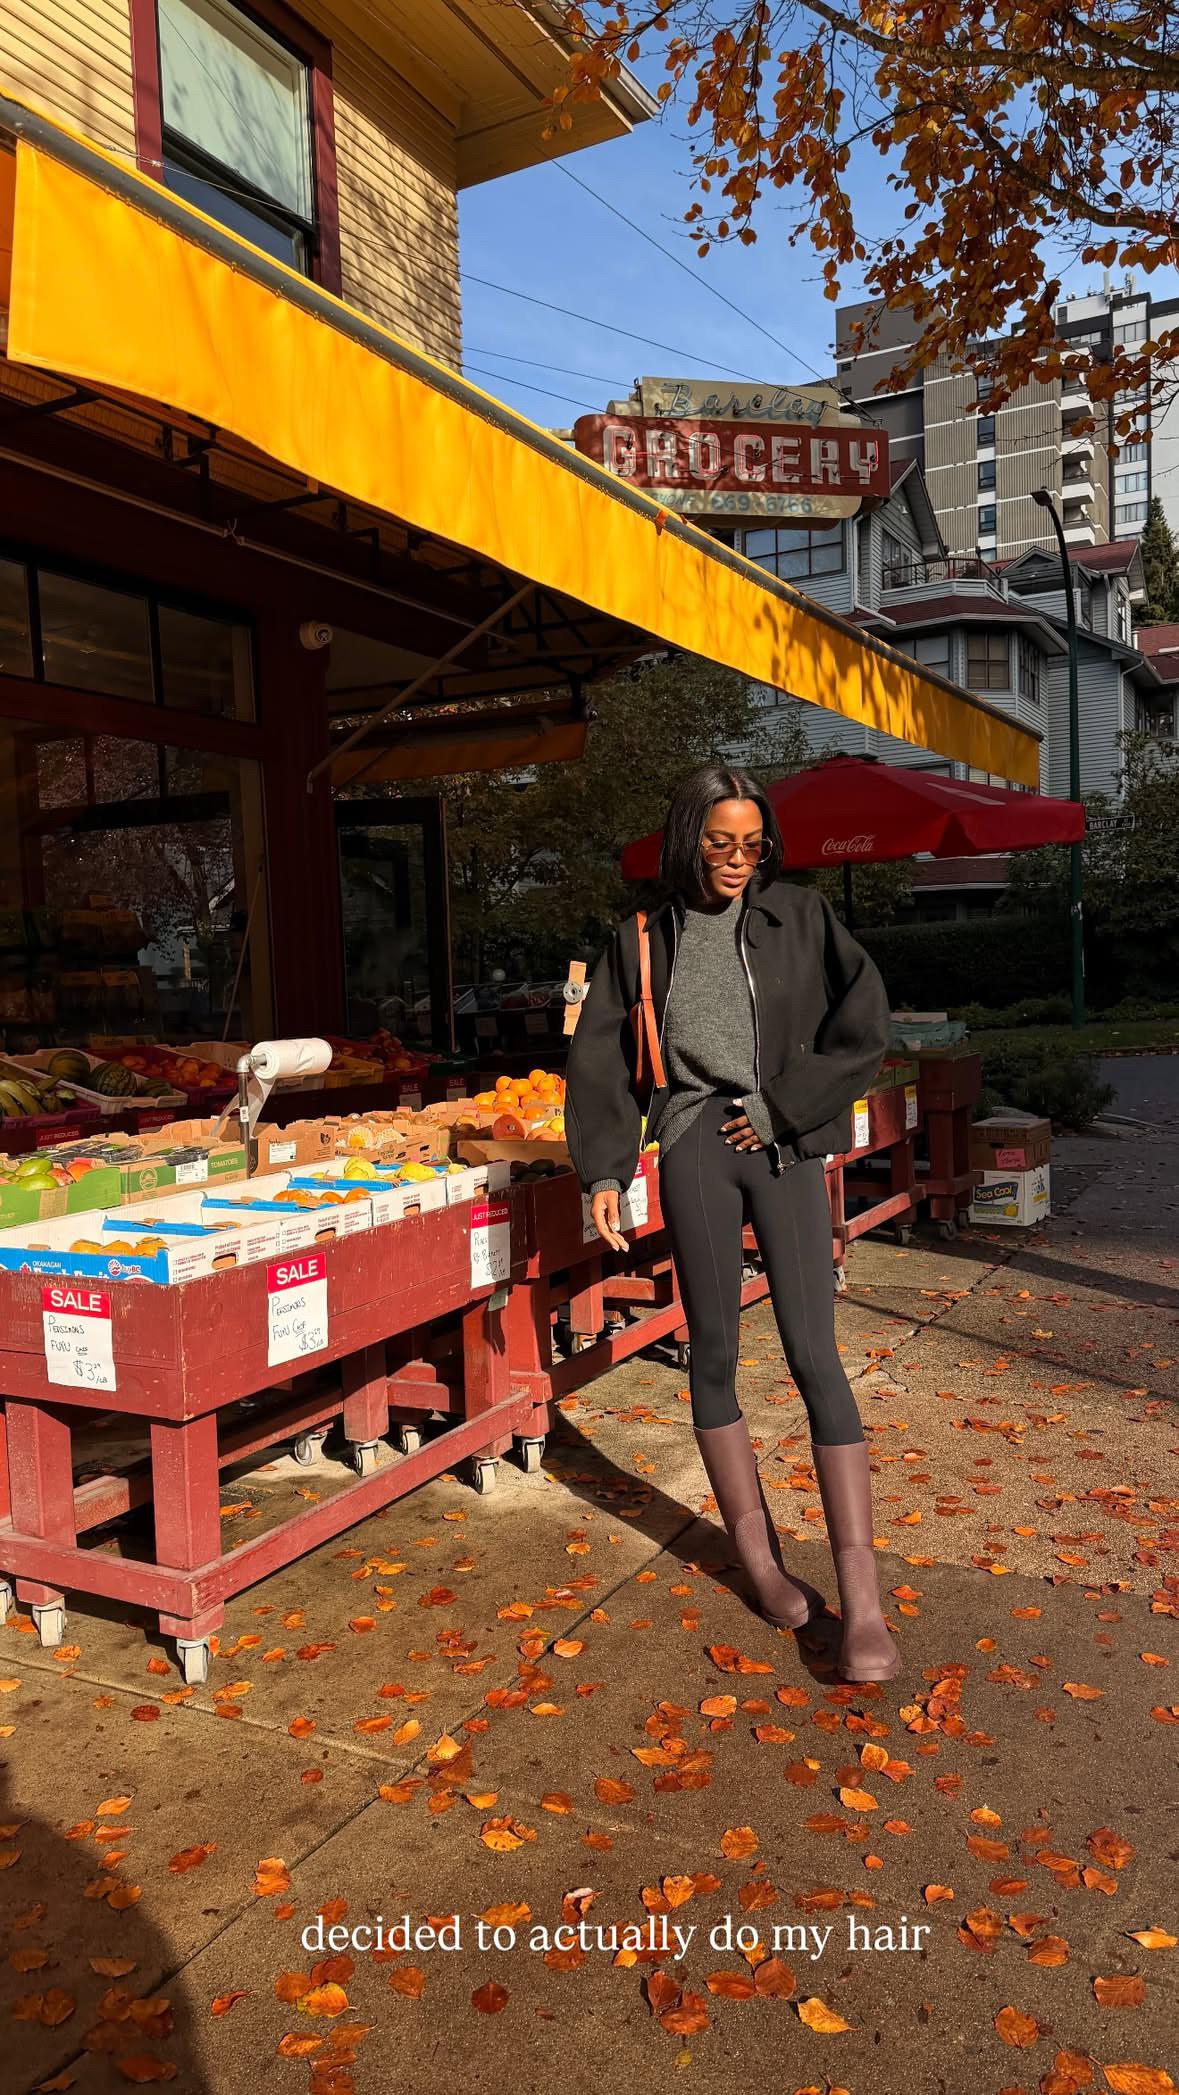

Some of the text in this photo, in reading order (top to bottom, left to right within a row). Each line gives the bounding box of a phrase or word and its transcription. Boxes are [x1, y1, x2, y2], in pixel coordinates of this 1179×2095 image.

[656, 383, 828, 430] Barclay
[602, 424, 880, 485] GROCERY
[1089, 819, 1118, 830] BARCLAY
[210, 1157, 239, 1169] TOMATOES
[976, 1190, 993, 1200] Sea
[472, 1207, 508, 1221] JUST REDUCED
[276, 1259, 319, 1285] SALE
[50, 1289, 102, 1312] SALE
